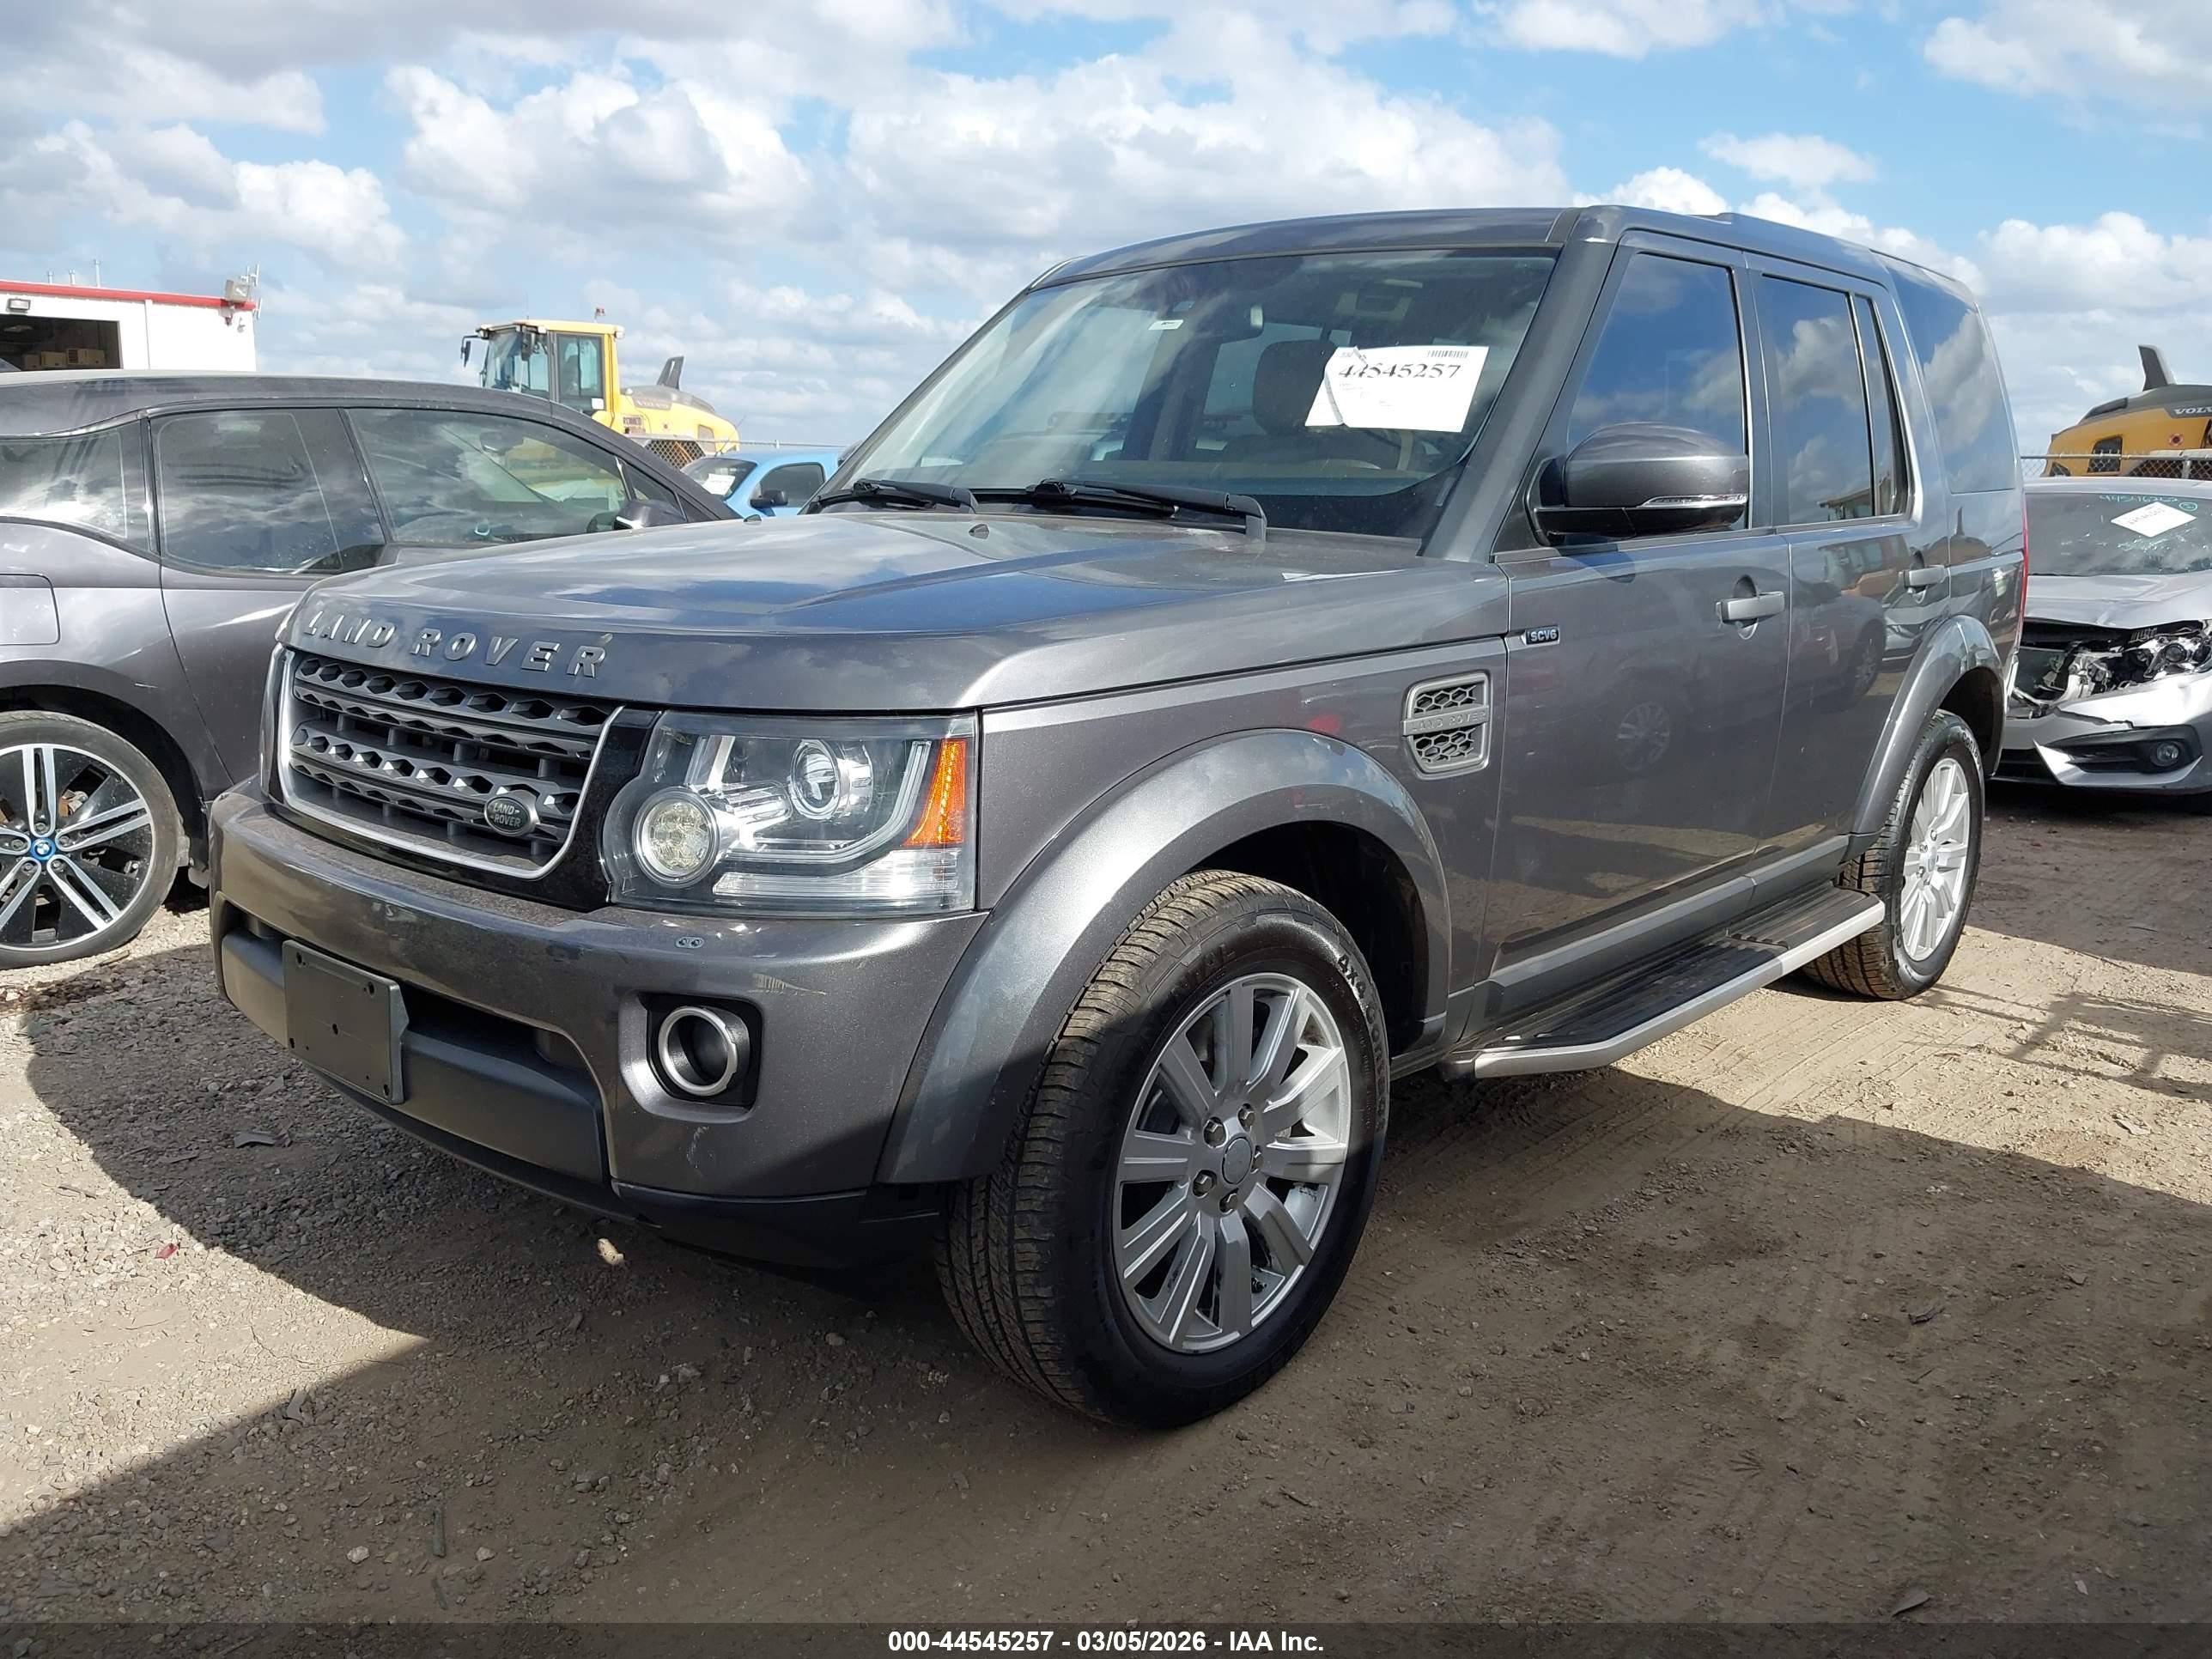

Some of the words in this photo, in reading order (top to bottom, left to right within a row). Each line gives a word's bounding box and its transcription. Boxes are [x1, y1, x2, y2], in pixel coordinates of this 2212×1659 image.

[1338, 362, 1462, 379] 44545257
[1530, 629, 1558, 642] SCV6
[304, 611, 396, 647] LAND
[410, 627, 606, 678] ROVER
[1449, 710, 1486, 726] ROVER
[493, 802, 515, 815] LAND
[494, 813, 521, 827] ROVER
